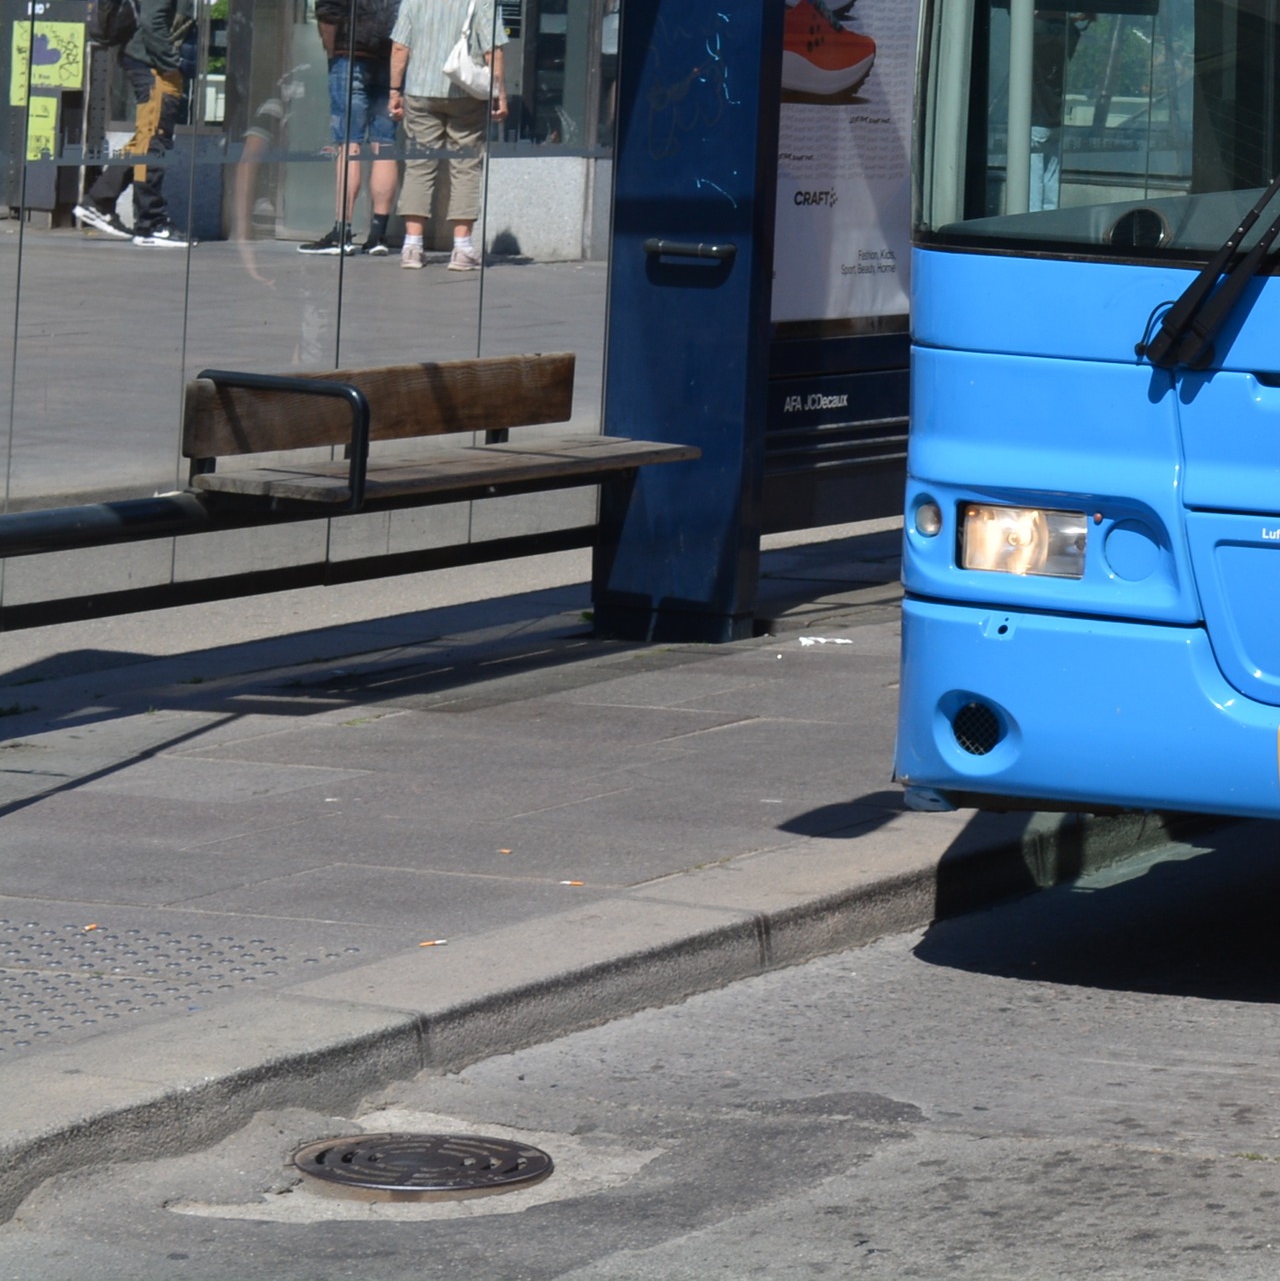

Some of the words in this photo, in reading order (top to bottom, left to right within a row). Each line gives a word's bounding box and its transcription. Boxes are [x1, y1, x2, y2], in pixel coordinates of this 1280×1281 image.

[794, 190, 830, 206] CRAFT
[877, 263, 896, 273] Home
[784, 395, 802, 412] AFA
[804, 394, 849, 410] JCDecaux
